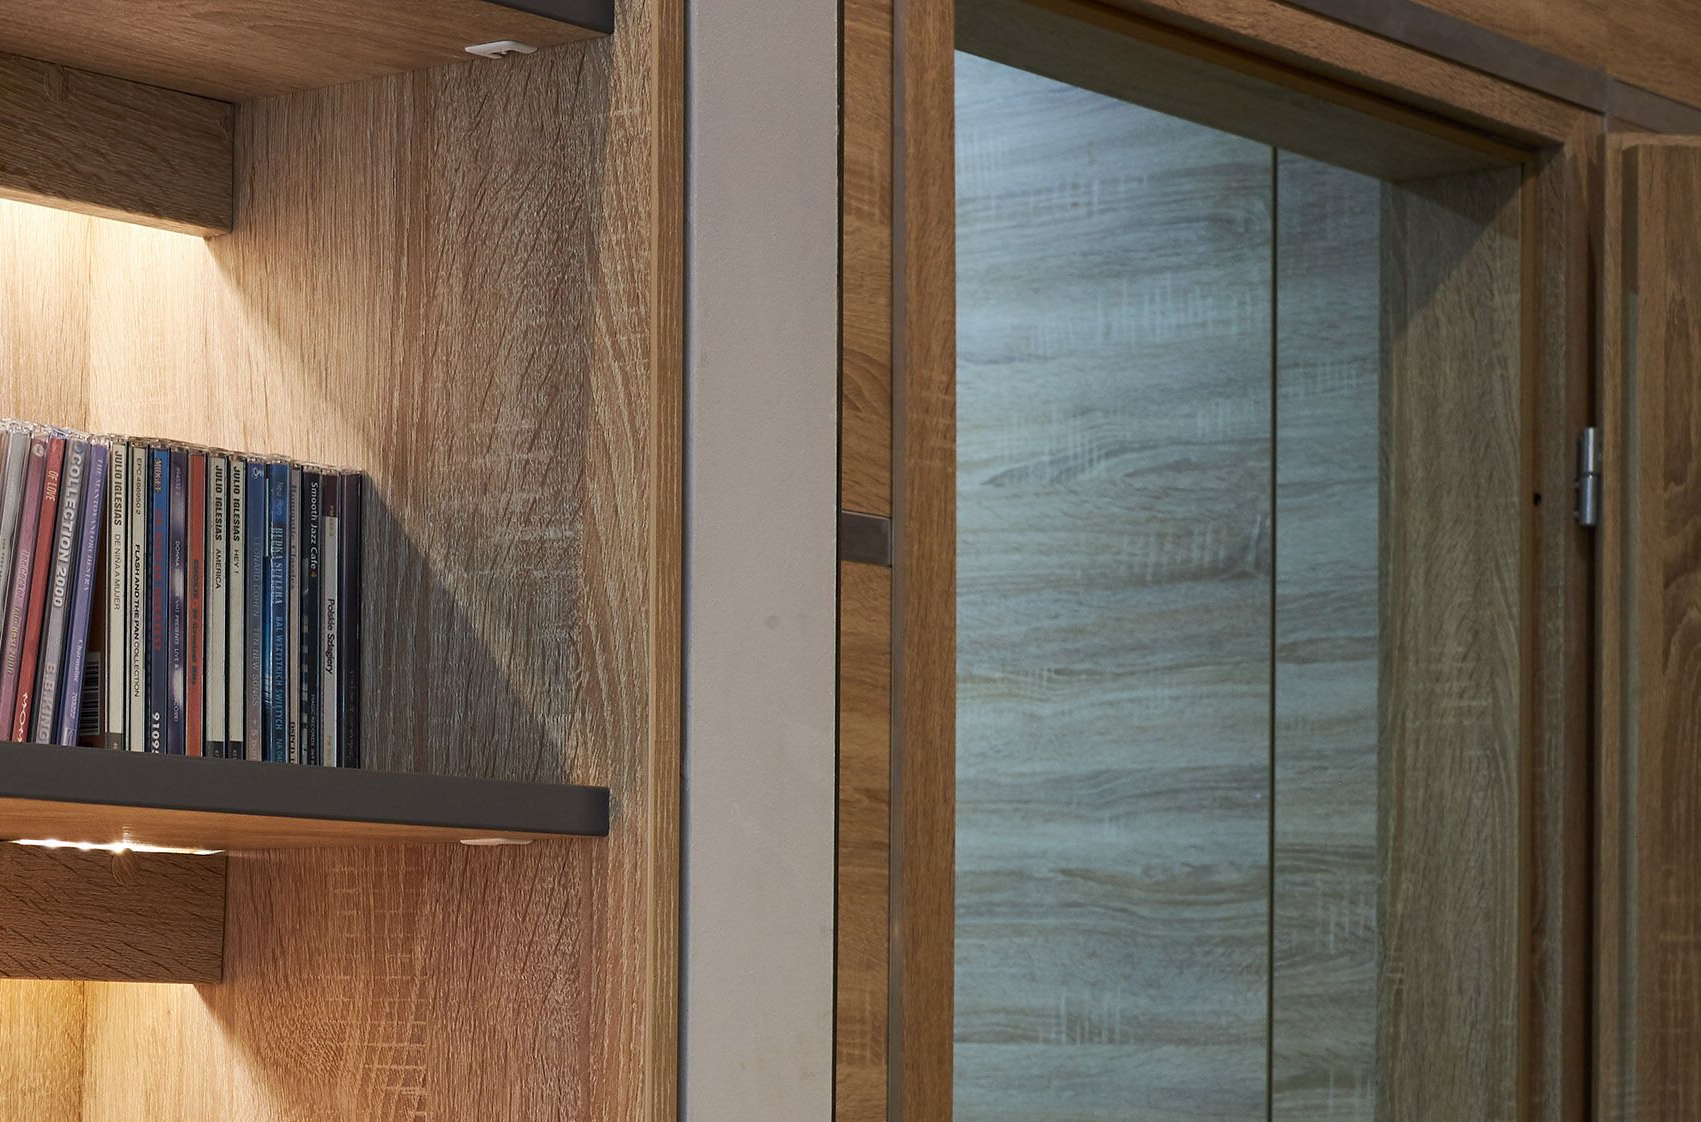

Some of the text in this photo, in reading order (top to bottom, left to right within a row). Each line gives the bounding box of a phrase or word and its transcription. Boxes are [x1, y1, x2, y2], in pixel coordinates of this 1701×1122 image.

[114, 450, 123, 480] JULIO
[215, 465, 223, 494] JULIO
[233, 466, 241, 495] JULIO
[45, 470, 59, 502] OF LOVE
[310, 481, 318, 522] Smooth
[113, 481, 122, 526] IGLESIAS
[233, 497, 241, 542] IGLESIAS
[54, 456, 82, 608] COLLECTION 2000
[114, 533, 121, 547] DE
[272, 527, 284, 560] BUDKA
[310, 525, 318, 544] Jazz
[214, 549, 222, 589] AMERICA
[310, 546, 318, 570] Cafe
[275, 616, 284, 632] BAL
[325, 598, 335, 675] Polskie Szlagiery
[252, 641, 260, 672] NEW
[275, 634, 284, 687] WSZYSTKICH
[252, 673, 260, 706] SONGS
